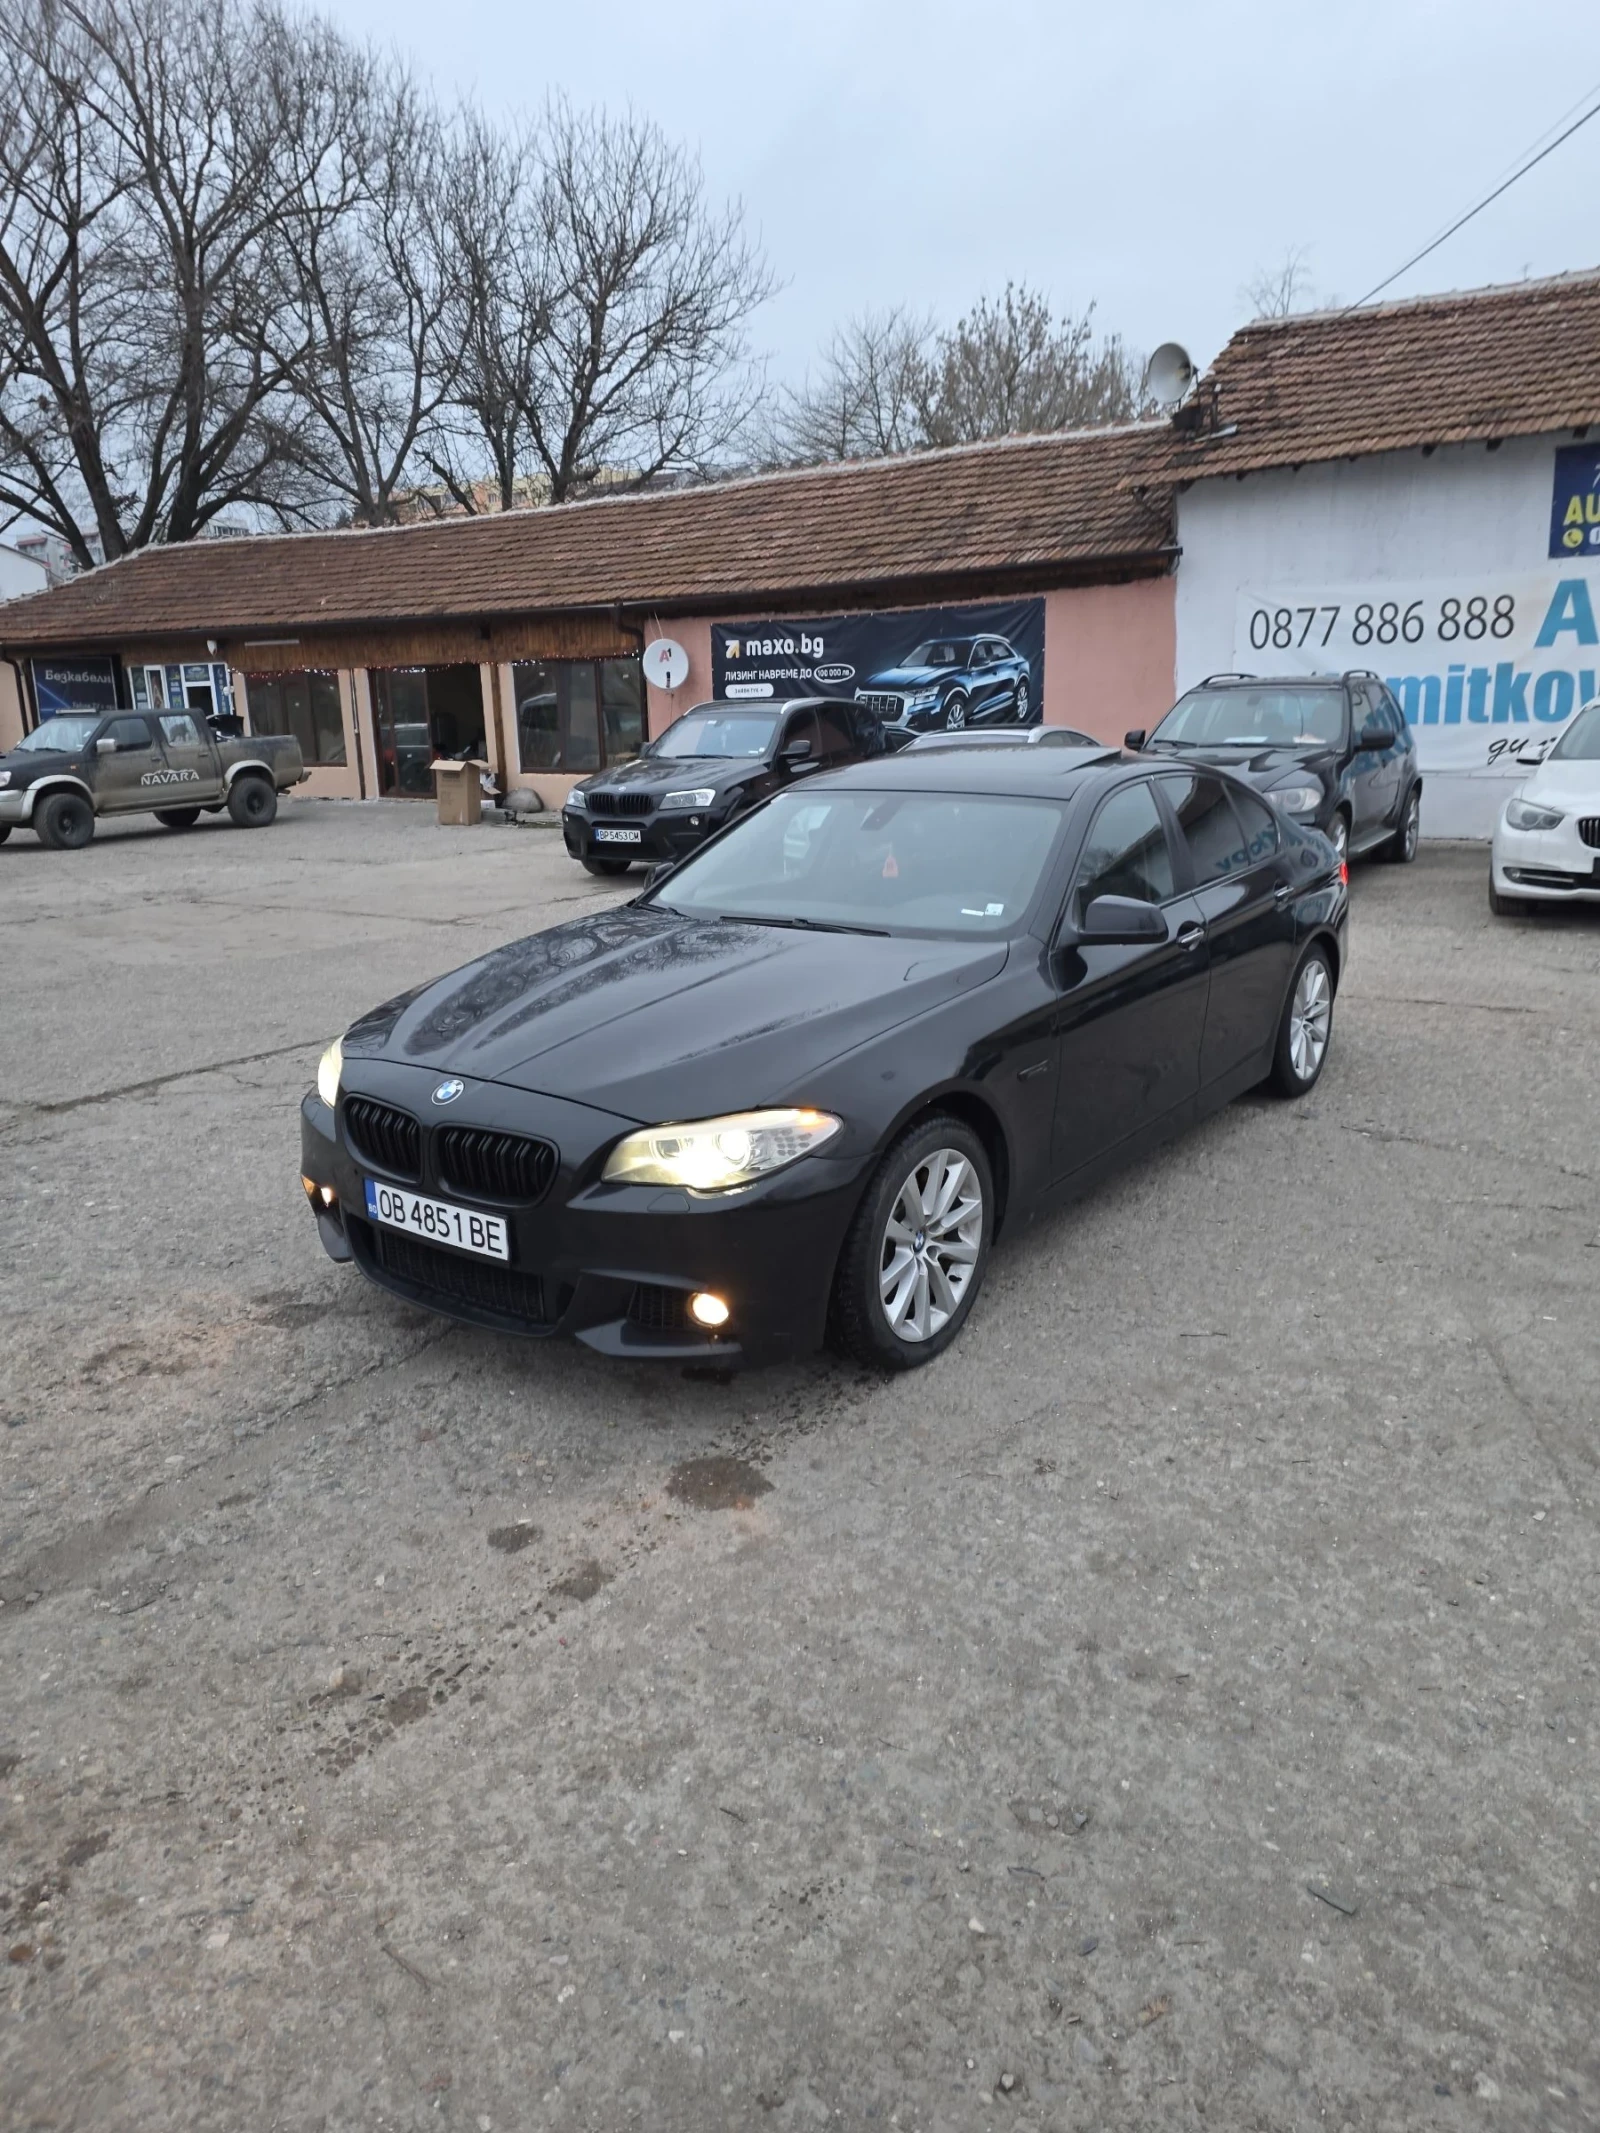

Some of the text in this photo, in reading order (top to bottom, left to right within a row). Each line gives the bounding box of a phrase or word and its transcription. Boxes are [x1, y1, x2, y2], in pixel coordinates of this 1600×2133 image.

[1250, 594, 1515, 650] 0877 886 888
[746, 633, 824, 658] maxo.bg
[725, 670, 758, 681] ЛИЗИНГ
[759, 669, 798, 680] НАВРЕМЕ
[800, 669, 812, 680] ДО
[141, 771, 200, 786] NAVARA
[379, 1190, 503, 1253] OB 4851 BE
